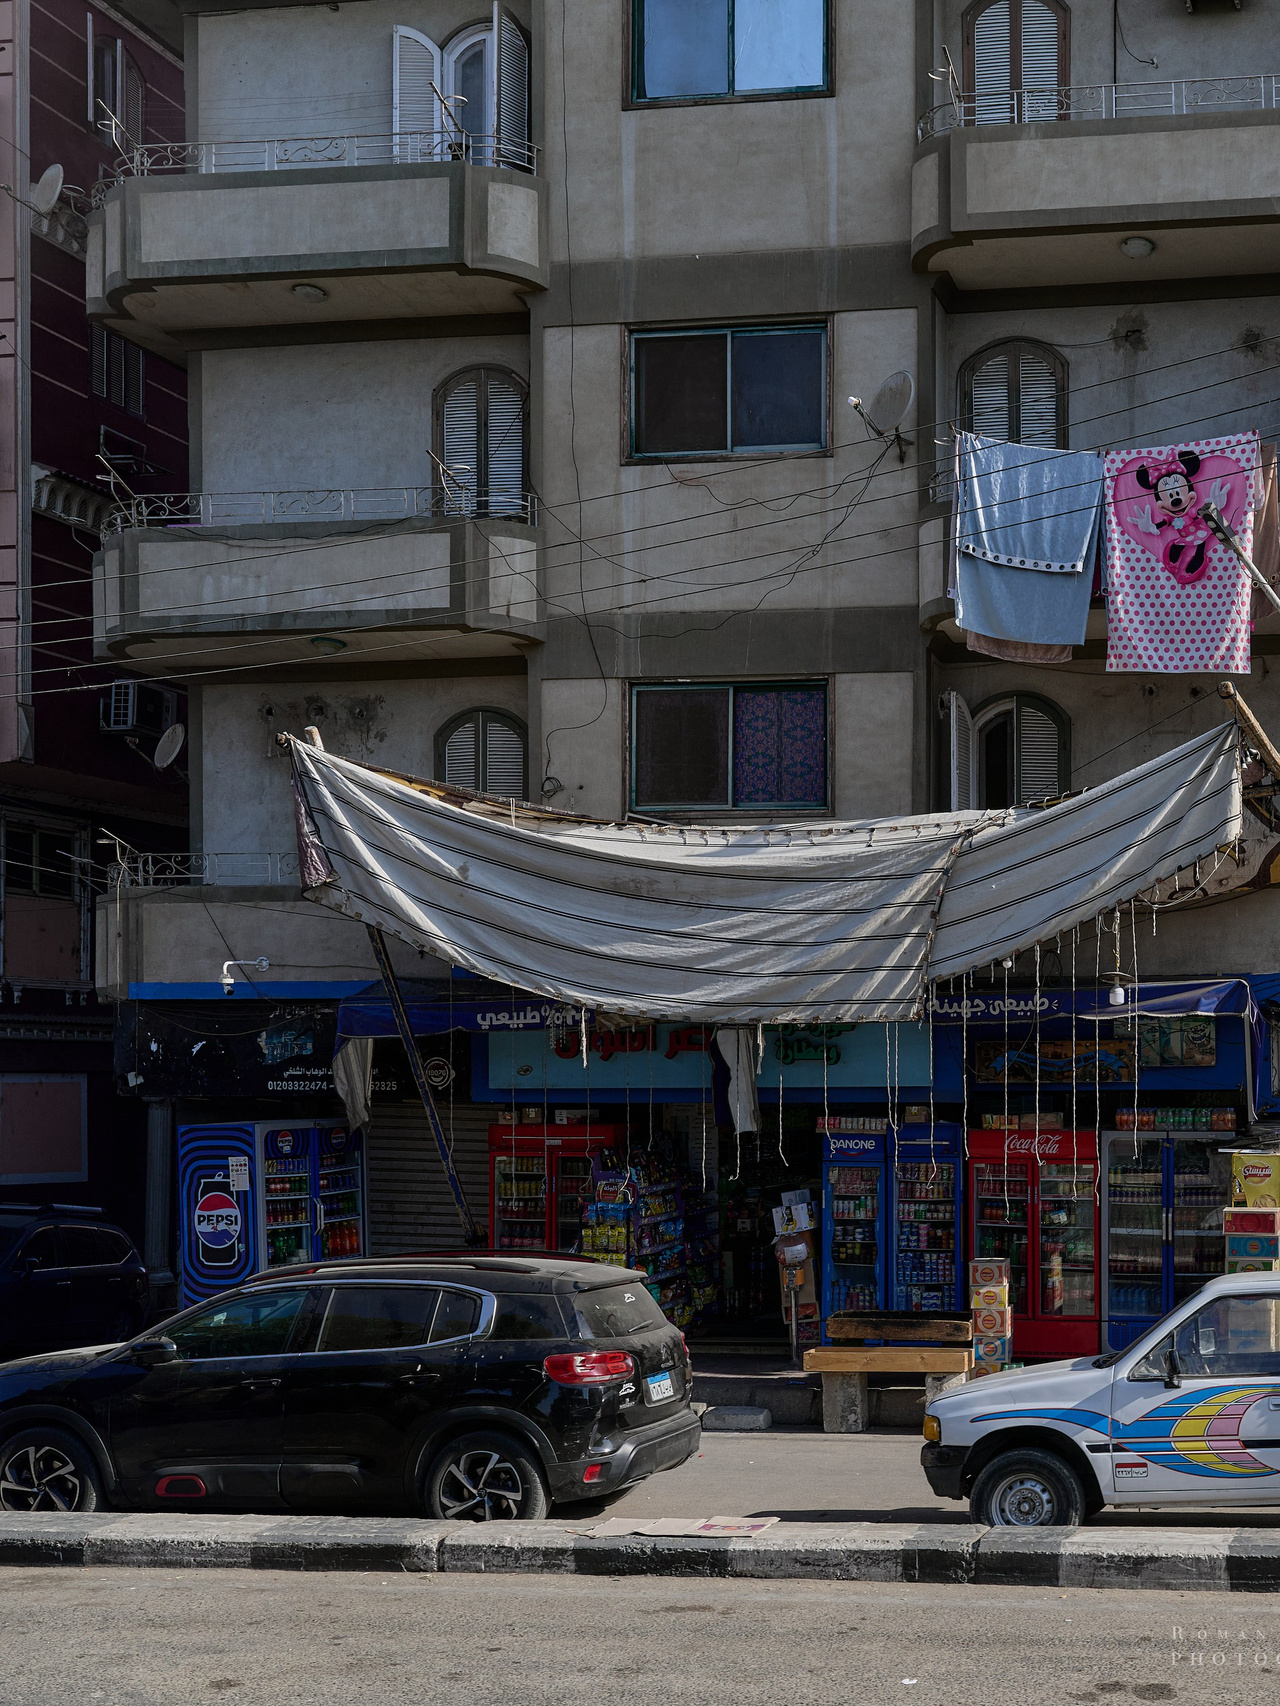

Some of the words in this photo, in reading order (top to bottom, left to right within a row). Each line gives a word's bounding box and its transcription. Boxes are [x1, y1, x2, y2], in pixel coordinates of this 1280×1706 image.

[476, 1006, 540, 1030] طبيعي
[267, 1080, 328, 1091] 01203322474
[197, 1214, 238, 1226] PEPSI
